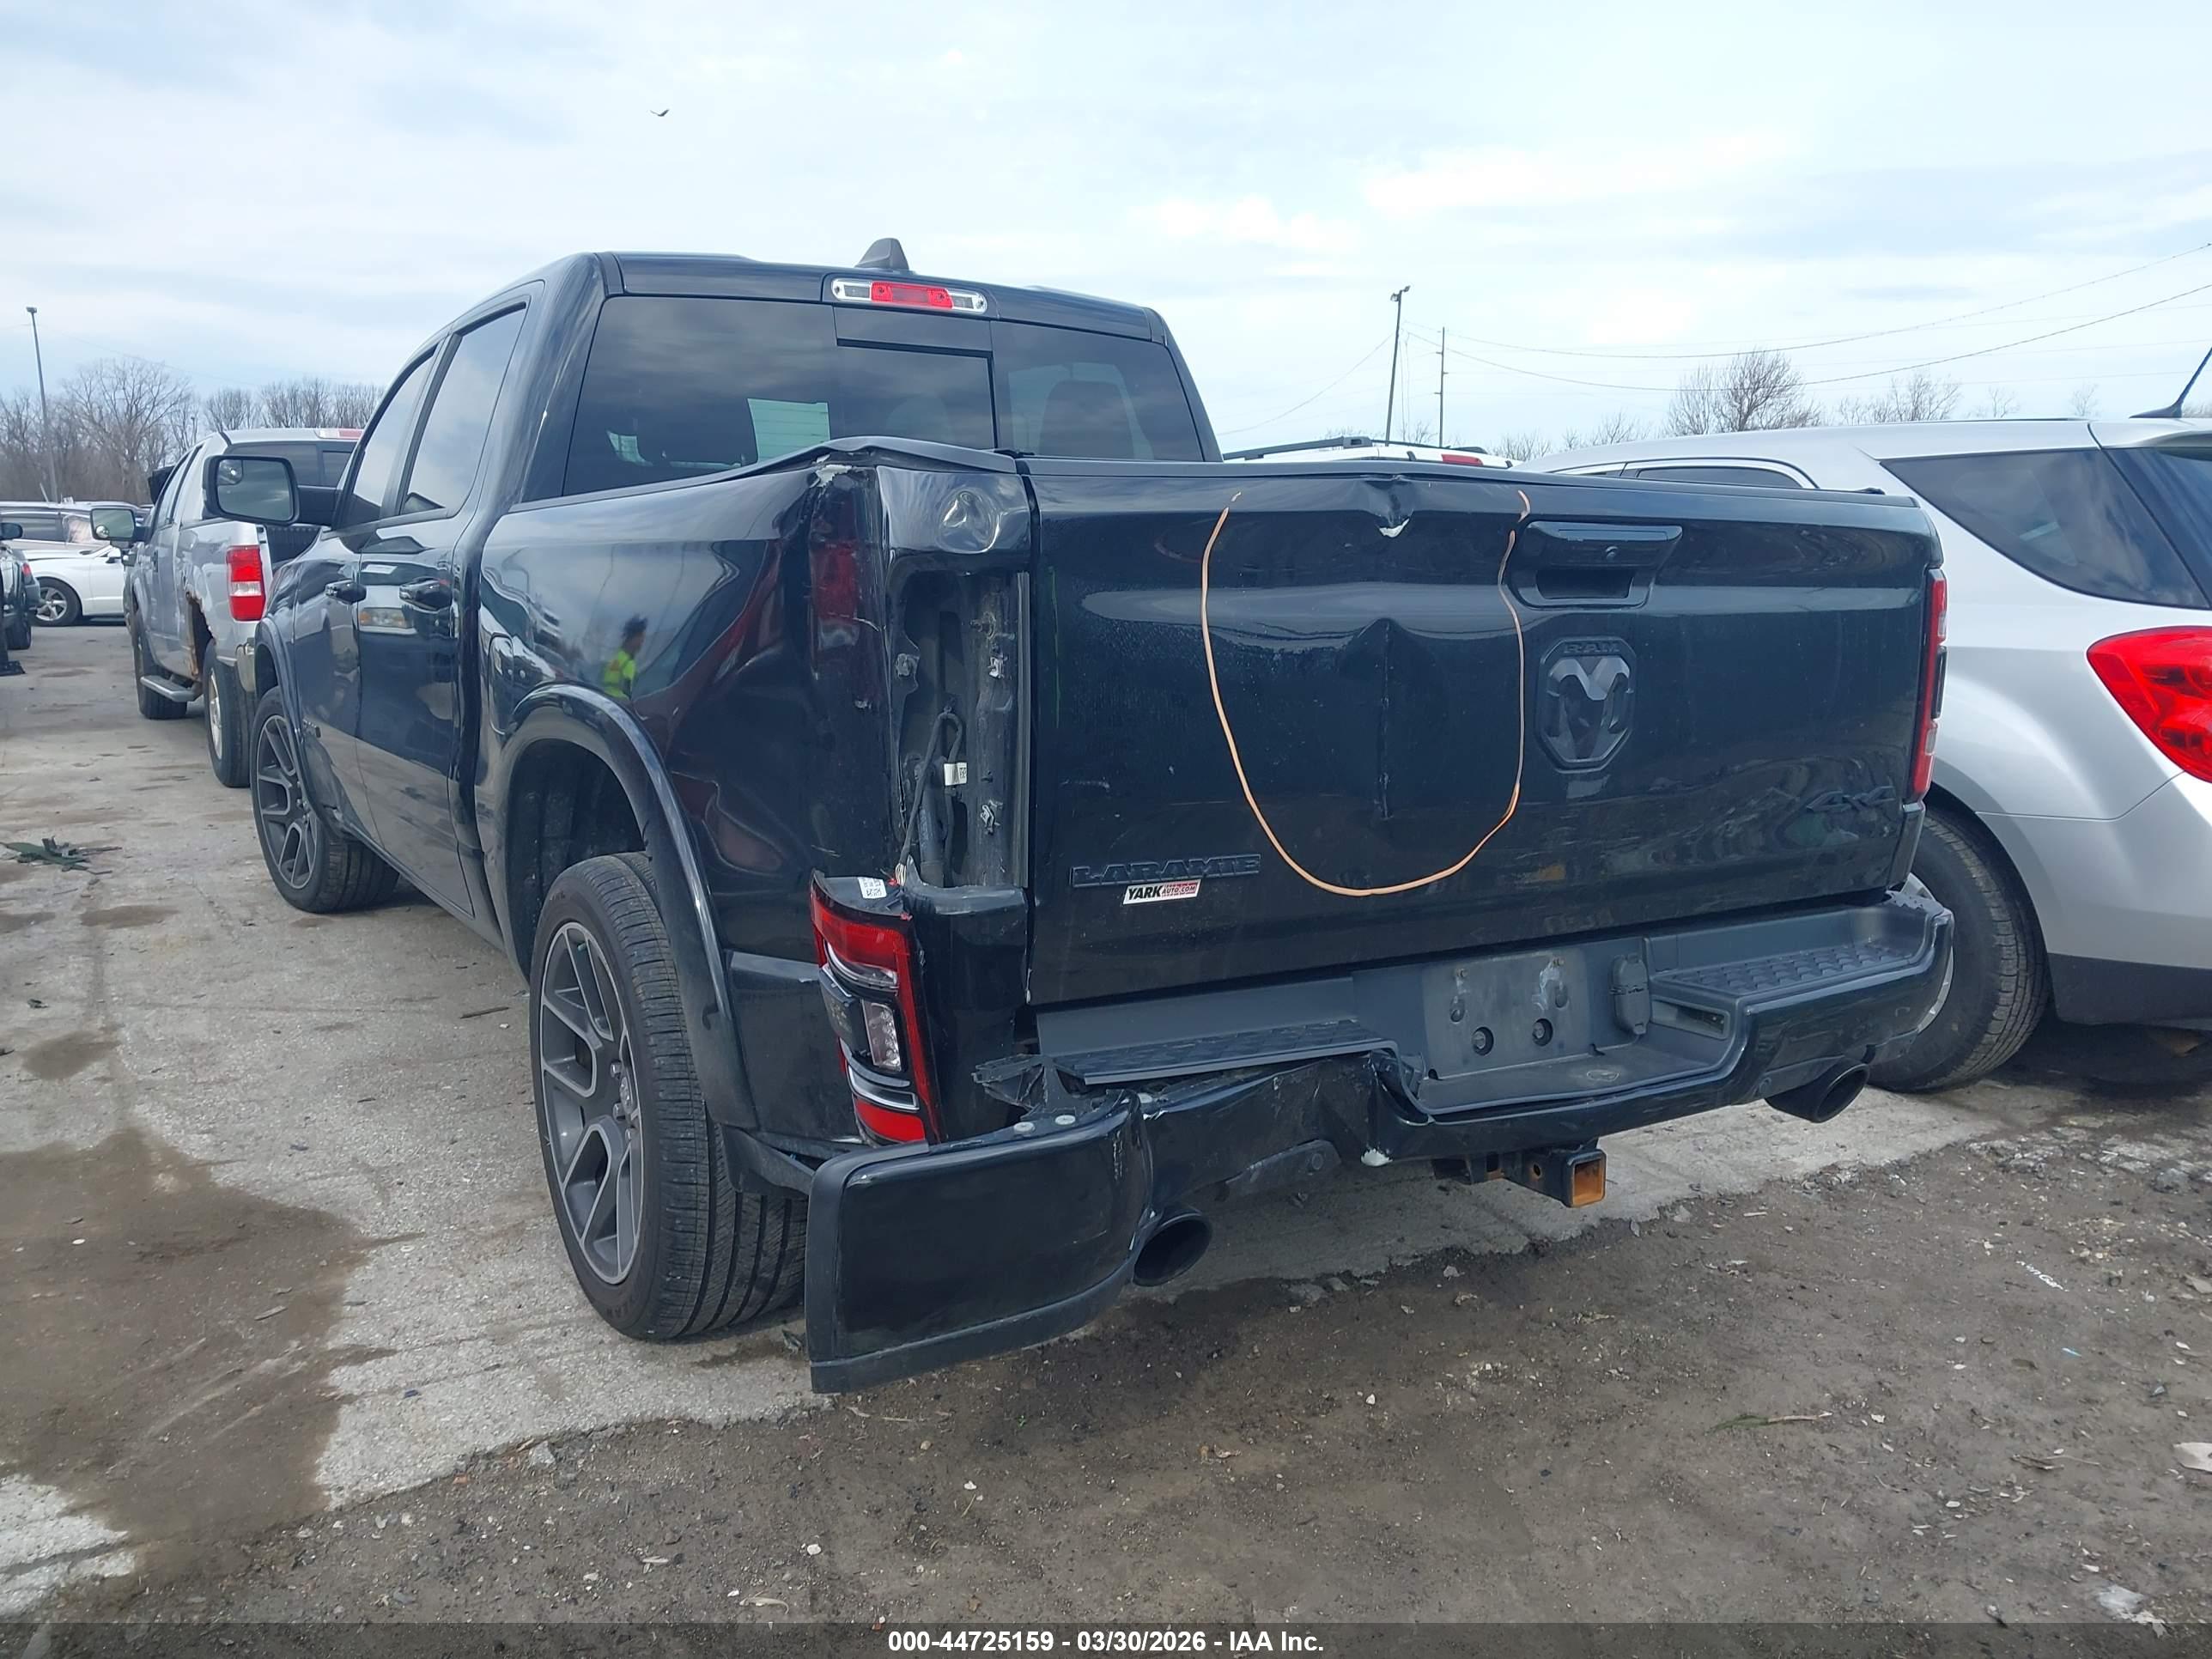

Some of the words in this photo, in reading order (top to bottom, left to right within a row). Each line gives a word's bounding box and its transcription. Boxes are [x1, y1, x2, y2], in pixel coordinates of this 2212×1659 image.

[1564, 641, 1620, 653] RAM
[1070, 854, 1261, 887] LARAMIE
[1127, 885, 1164, 901] YARK
